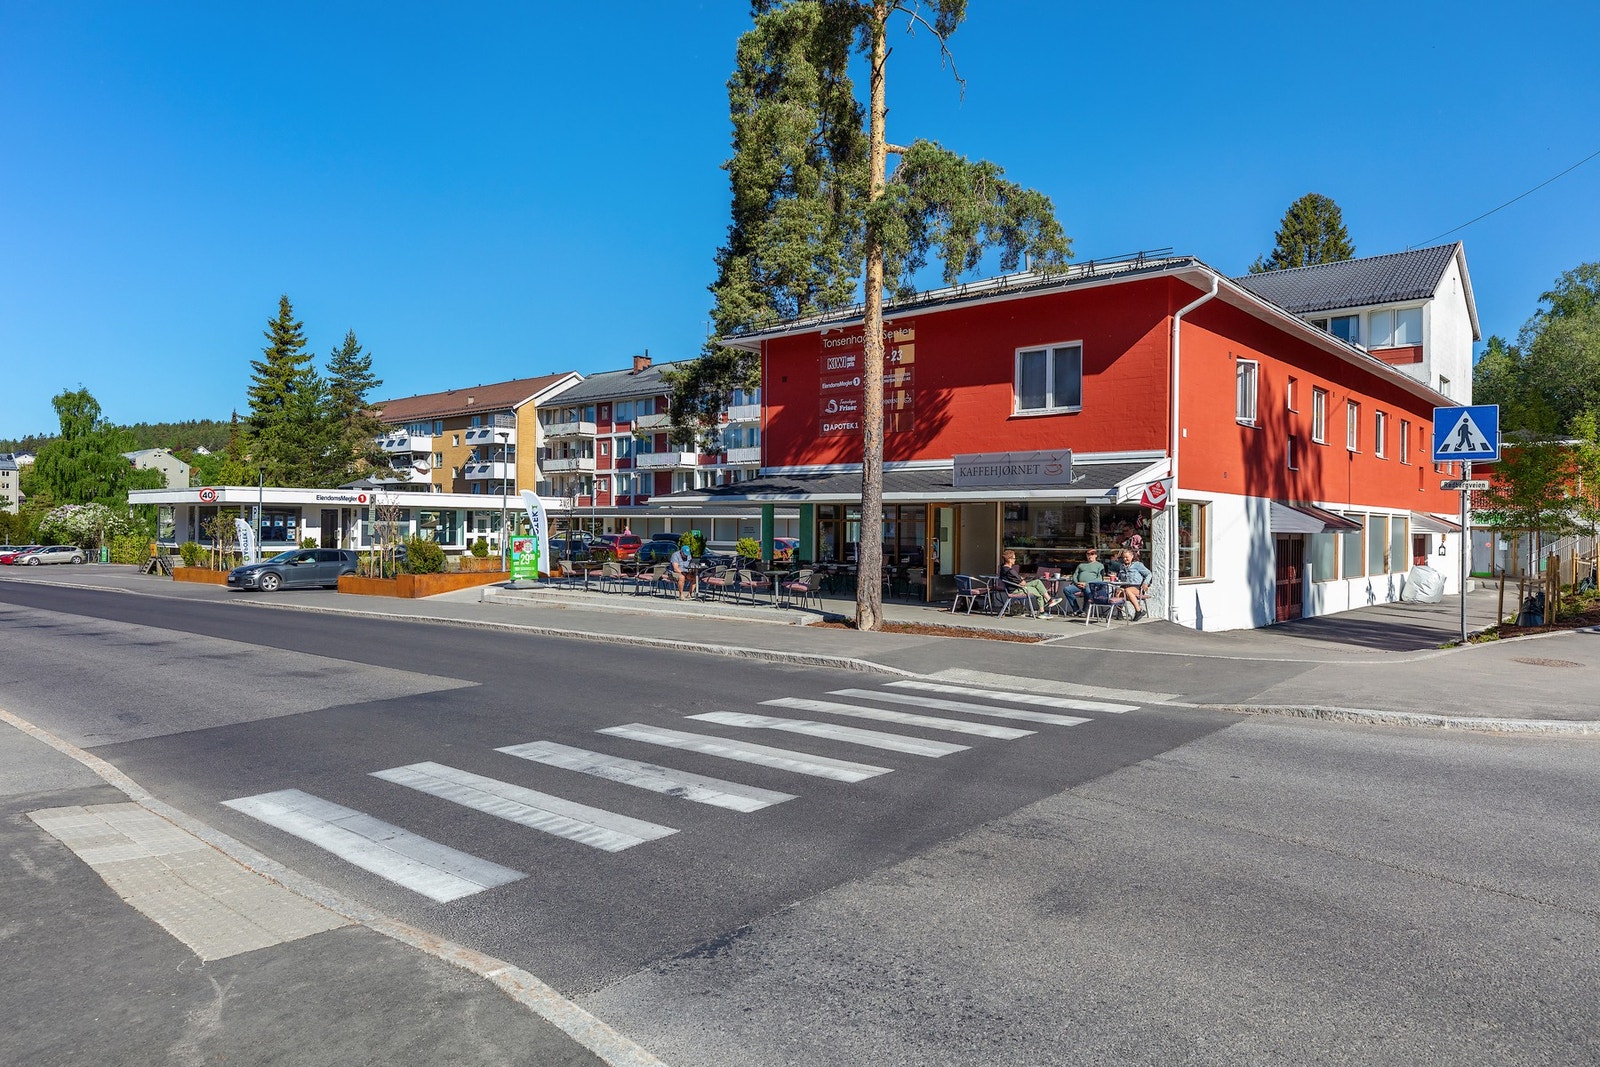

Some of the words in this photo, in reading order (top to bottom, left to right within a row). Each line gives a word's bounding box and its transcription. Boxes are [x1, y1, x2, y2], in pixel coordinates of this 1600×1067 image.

[827, 356, 846, 370] KIWI
[960, 464, 1041, 478] KAFFEHJØRNET
[520, 554, 530, 565] 29
